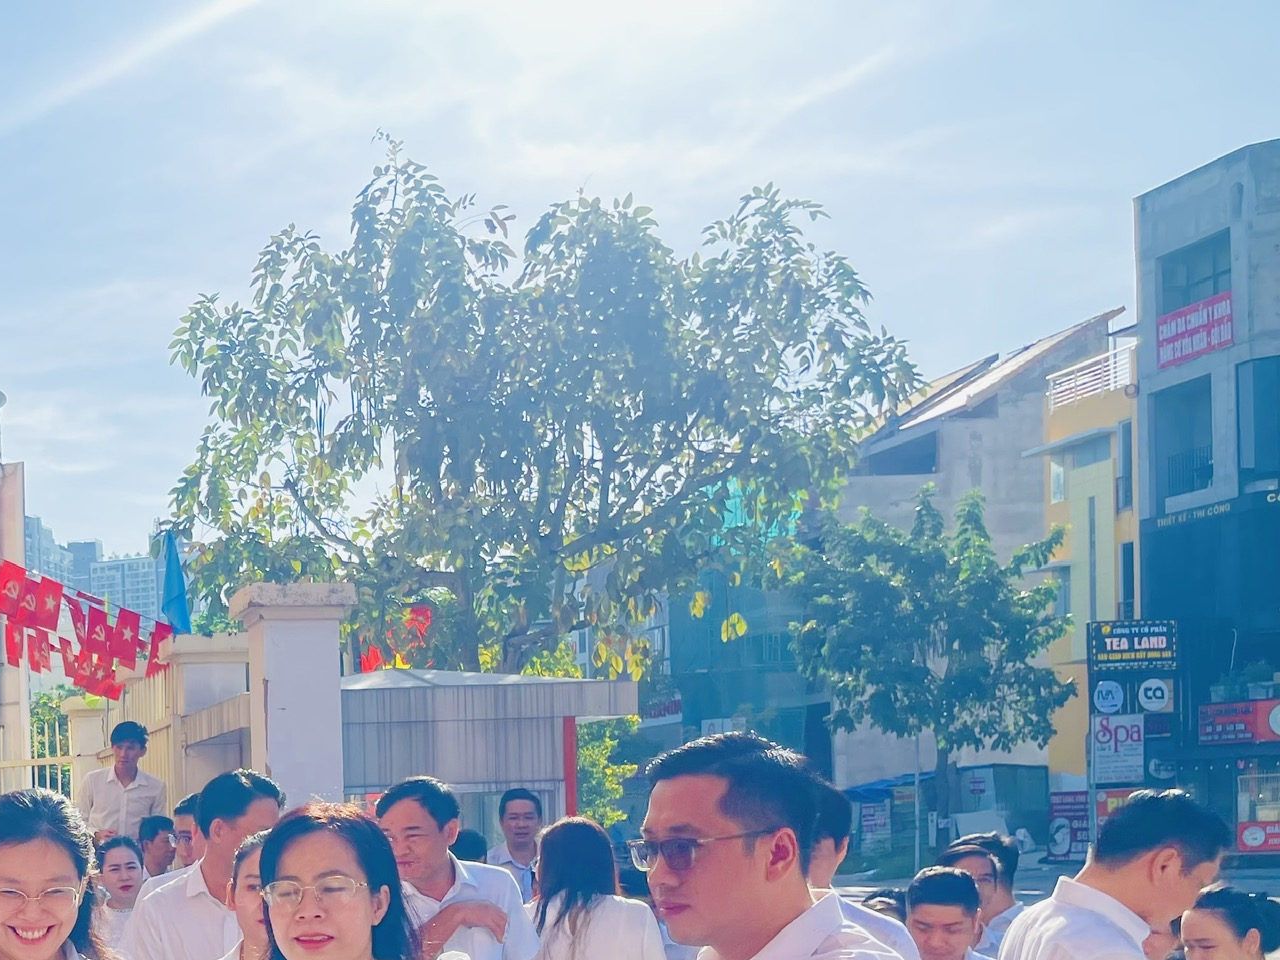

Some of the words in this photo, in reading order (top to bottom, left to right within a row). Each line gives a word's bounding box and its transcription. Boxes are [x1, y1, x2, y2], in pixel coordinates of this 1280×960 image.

[1193, 508, 1205, 520] THI
[1207, 503, 1231, 516] CÔNG
[1104, 637, 1129, 651] TEA
[1133, 635, 1167, 650] LAND
[1095, 716, 1142, 753] Spa
